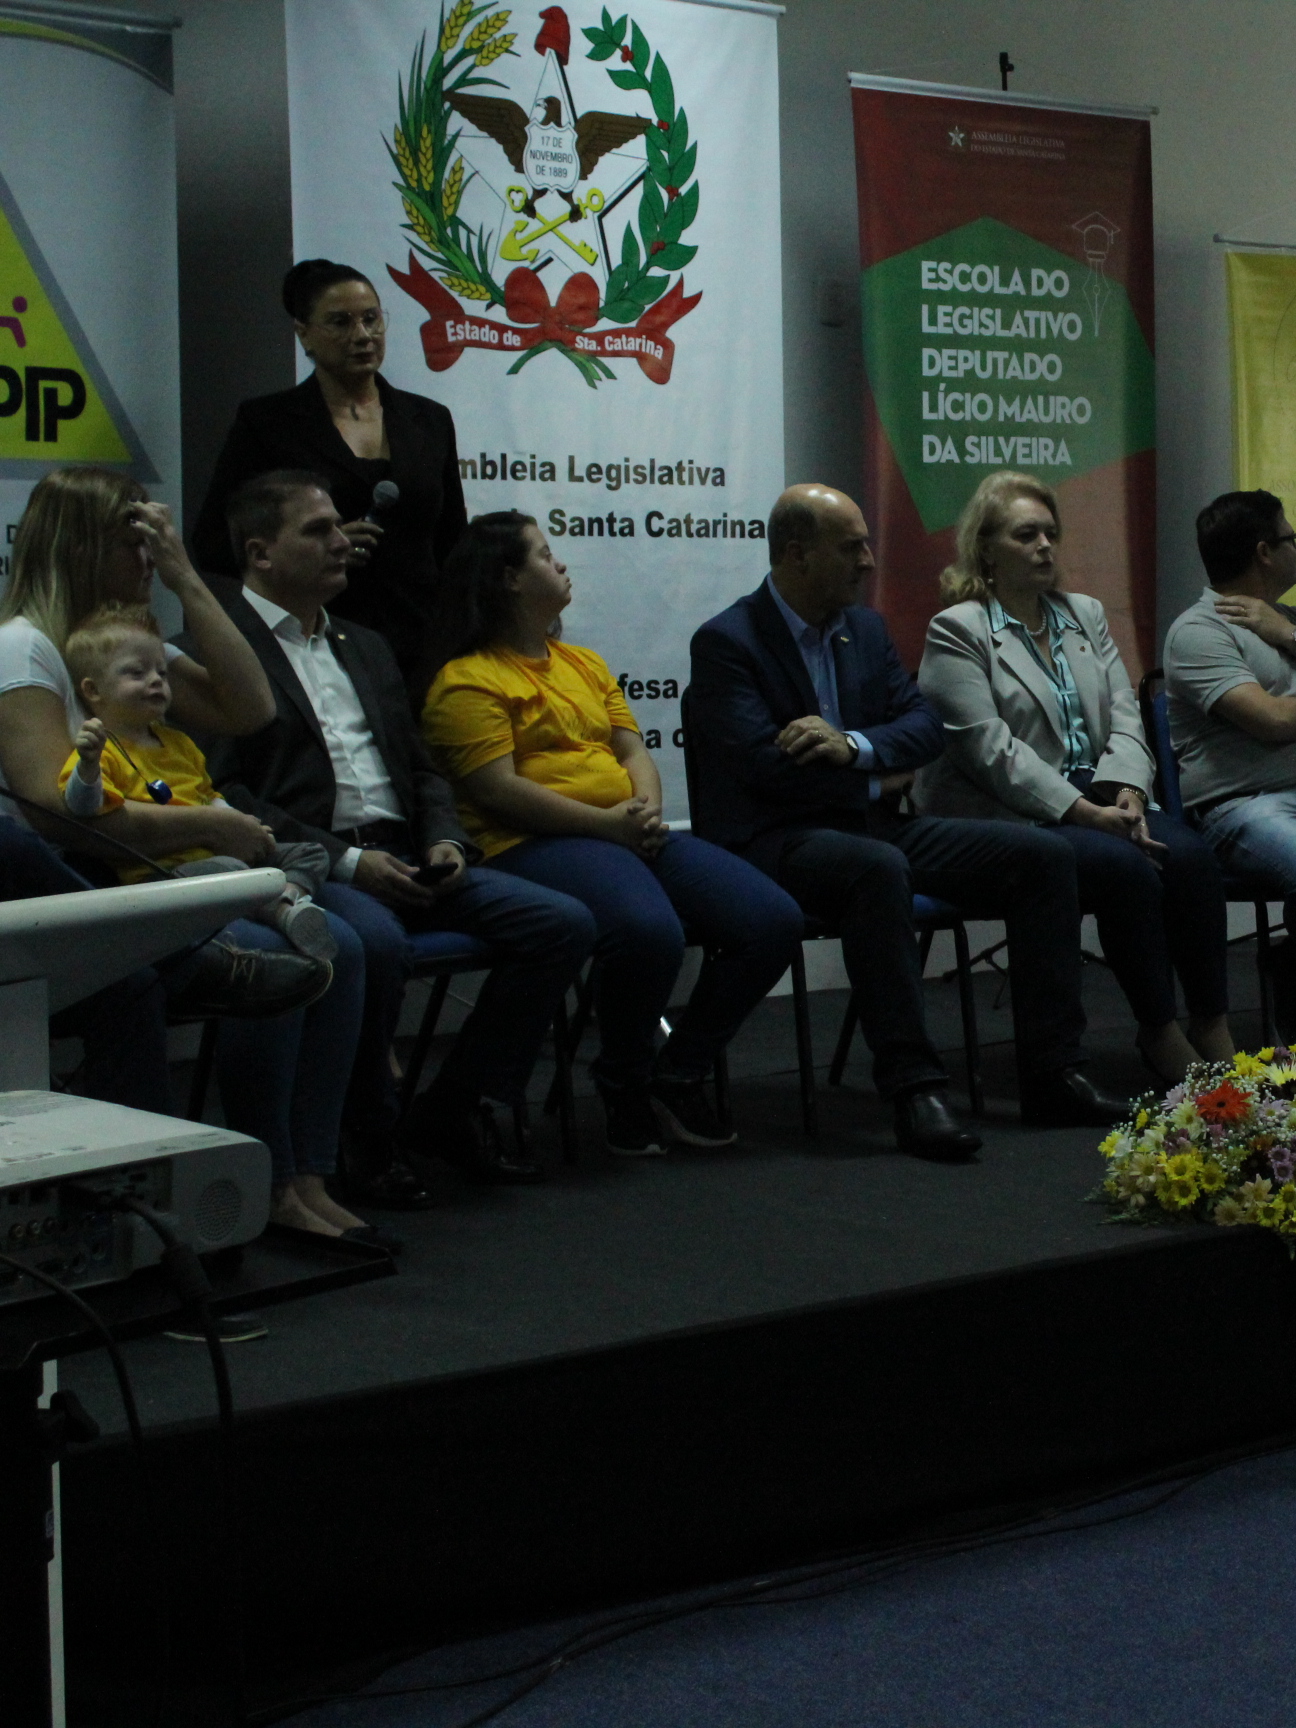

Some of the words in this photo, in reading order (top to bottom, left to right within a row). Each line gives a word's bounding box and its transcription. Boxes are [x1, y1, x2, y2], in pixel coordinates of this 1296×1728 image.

[529, 149, 573, 164] NOVEMBRO
[541, 135, 551, 146] 17
[552, 136, 563, 148] DE
[535, 164, 546, 176] DE
[549, 166, 568, 178] 1889
[921, 260, 1026, 296] ESCOLA
[1031, 268, 1070, 298] DO
[921, 304, 1082, 340] LEGISLATIVO
[445, 320, 499, 344] Estado
[503, 330, 521, 347] de
[575, 335, 601, 351] Sta.
[604, 335, 664, 360] Catarina
[921, 347, 1063, 382] DEPUTADO
[921, 383, 994, 422] LÍCIO
[998, 394, 1092, 425] MAURO
[922, 435, 962, 464] DA
[965, 435, 1072, 466] SILVEIRA
[457, 452, 556, 482] mbleia
[568, 455, 726, 491] Legislativa
[548, 508, 635, 538] Santa
[645, 510, 766, 540] Catarina
[618, 672, 679, 700] fesa
